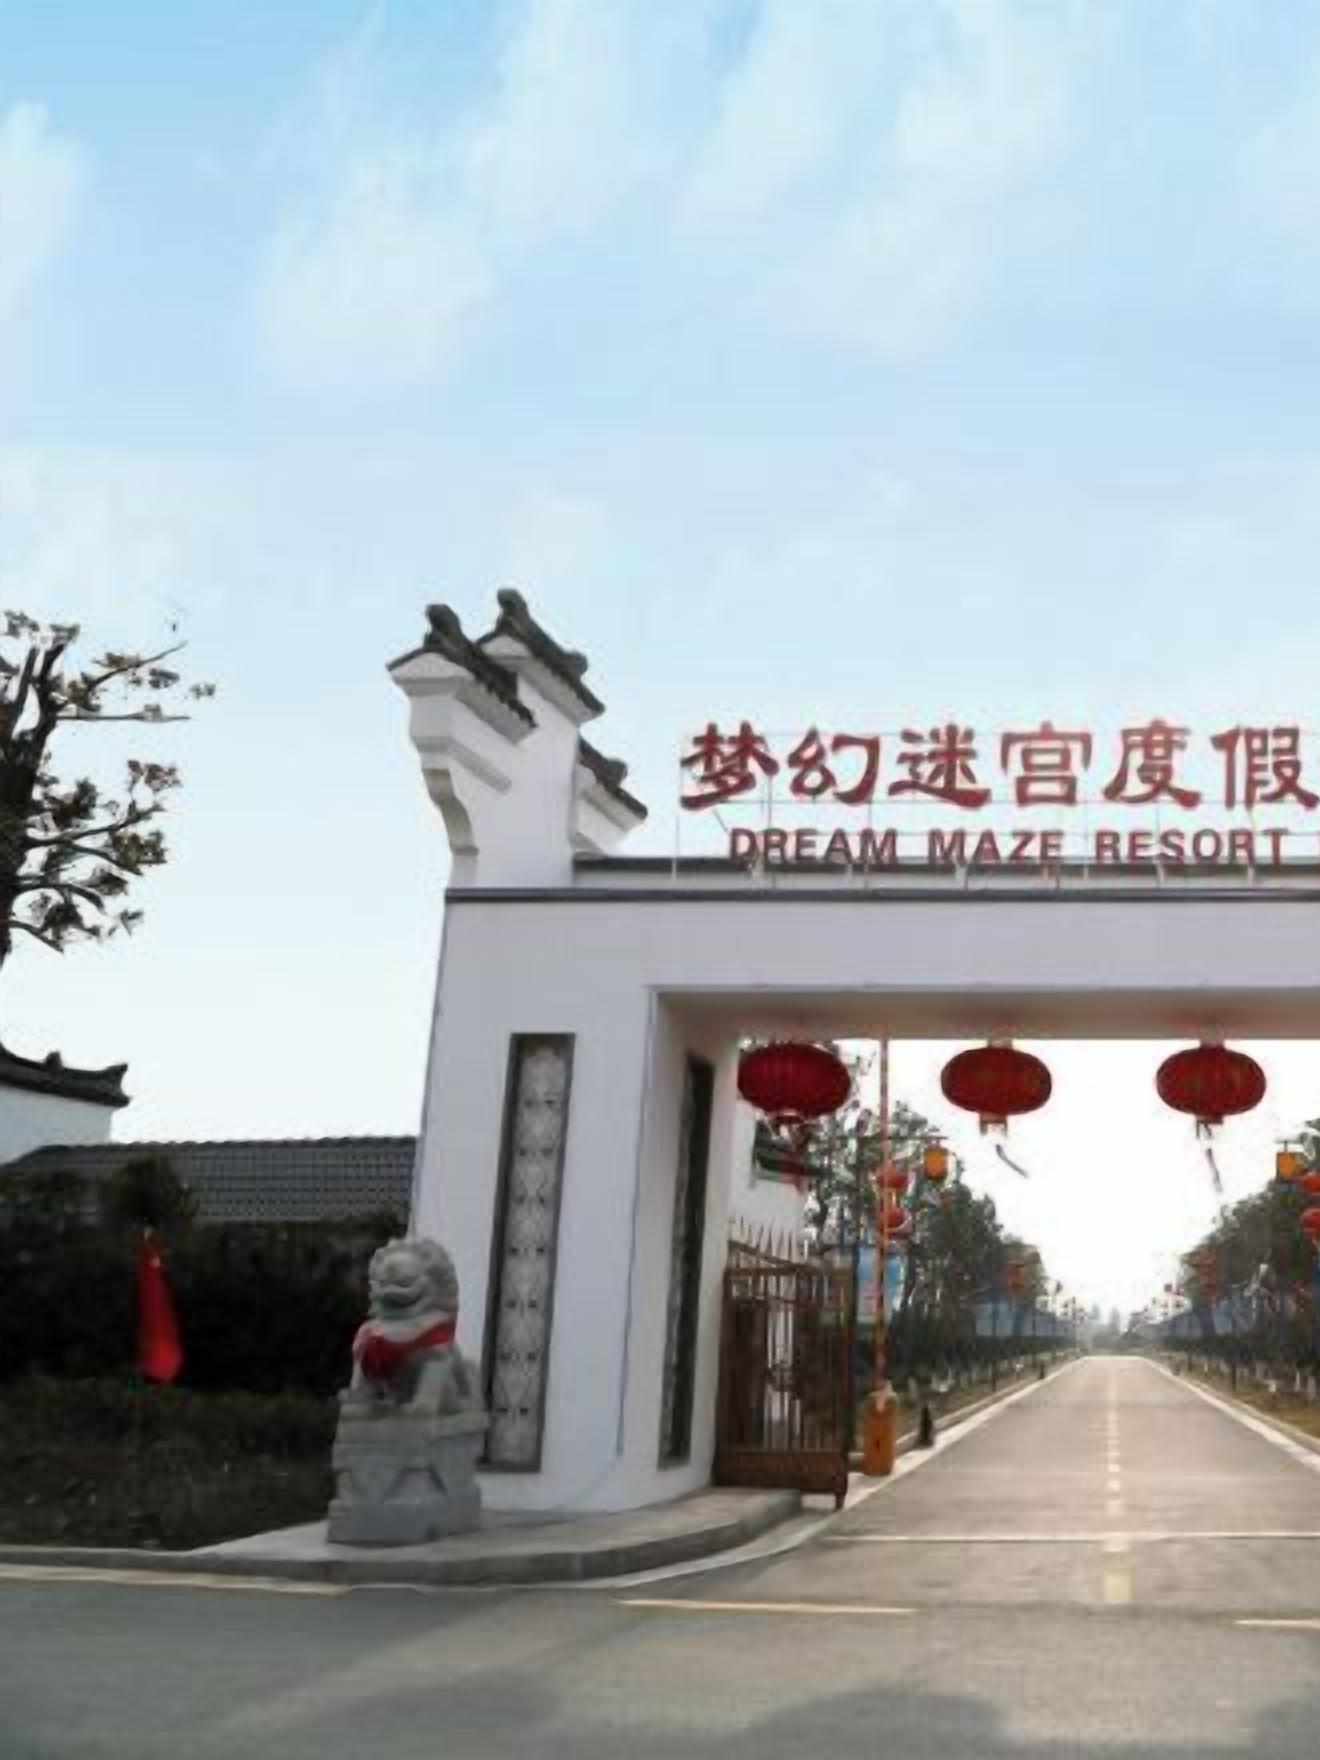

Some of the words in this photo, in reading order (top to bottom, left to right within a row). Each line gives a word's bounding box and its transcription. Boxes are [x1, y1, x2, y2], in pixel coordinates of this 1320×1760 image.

[729, 829, 897, 867] DREAM
[926, 830, 1065, 867] MAZE
[1095, 829, 1287, 867] RESORT
